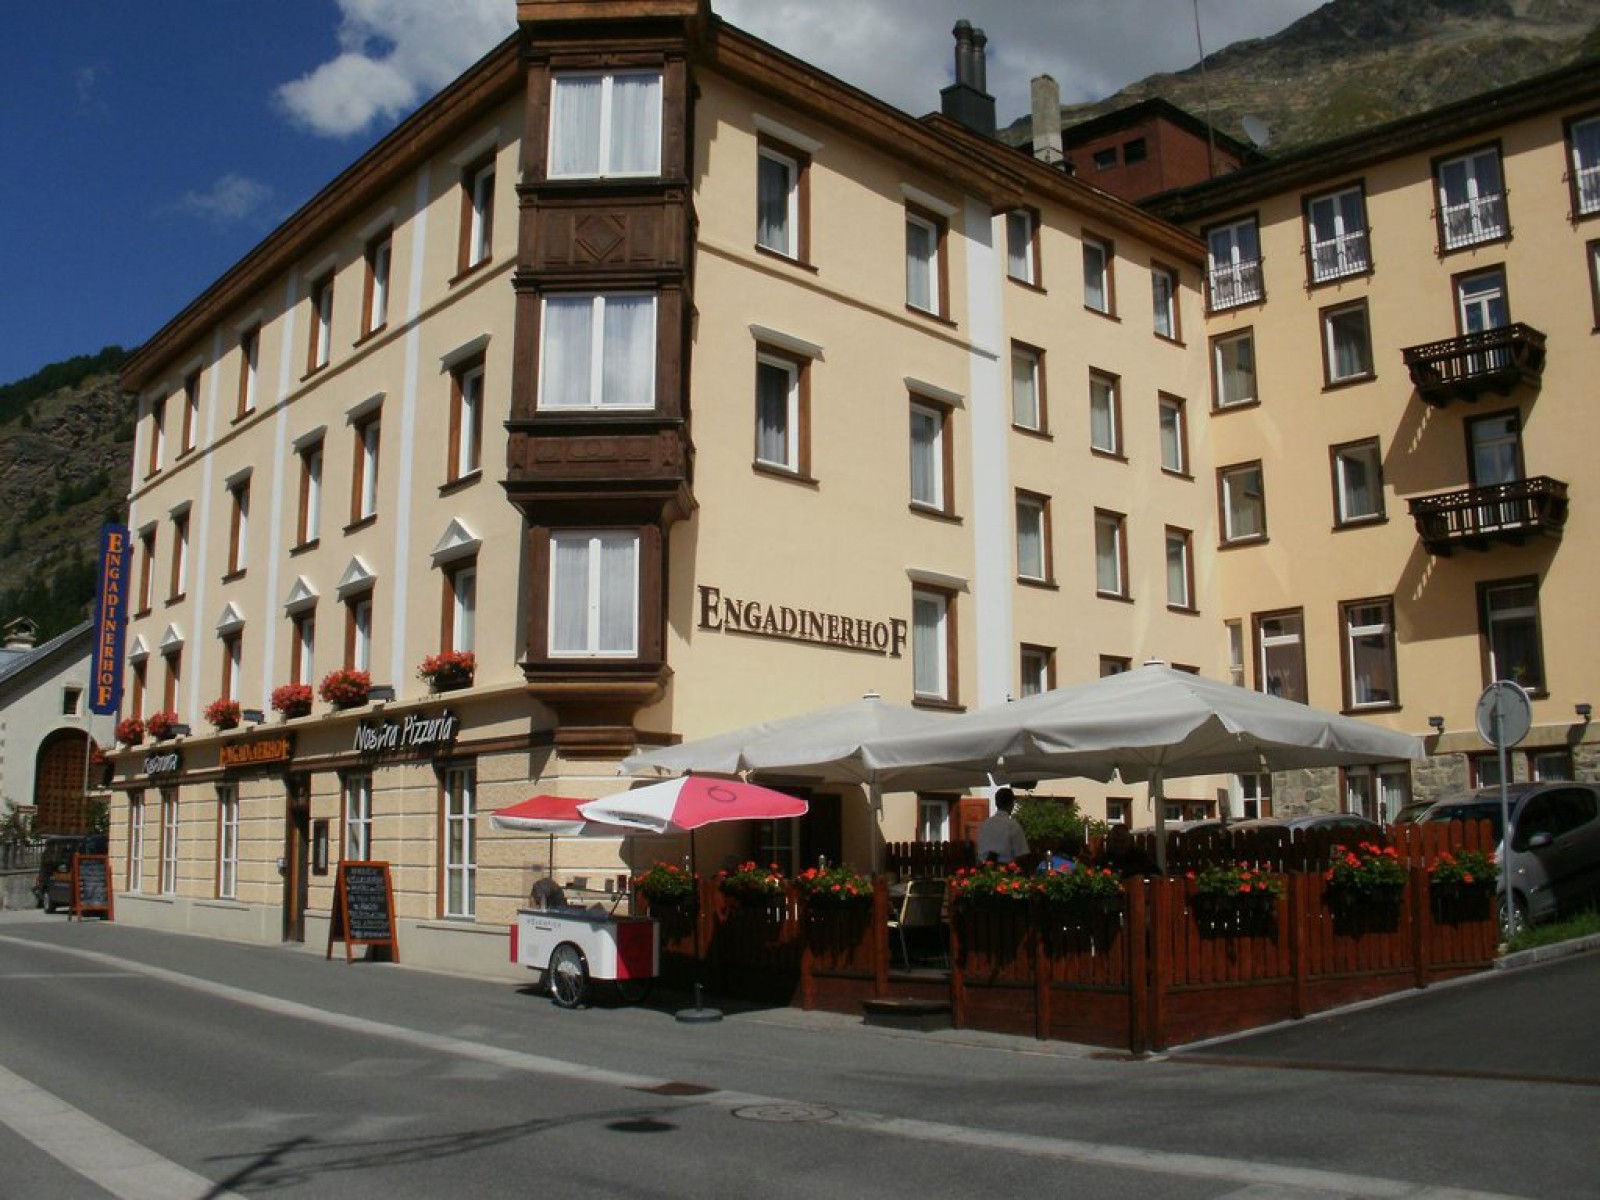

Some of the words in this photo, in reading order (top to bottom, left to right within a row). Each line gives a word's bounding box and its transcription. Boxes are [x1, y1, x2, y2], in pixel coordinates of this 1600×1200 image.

[97, 533, 123, 706] ENGADINERHOF
[697, 584, 907, 657] ENGADINERHOF
[400, 708, 456, 746] Pizzeria
